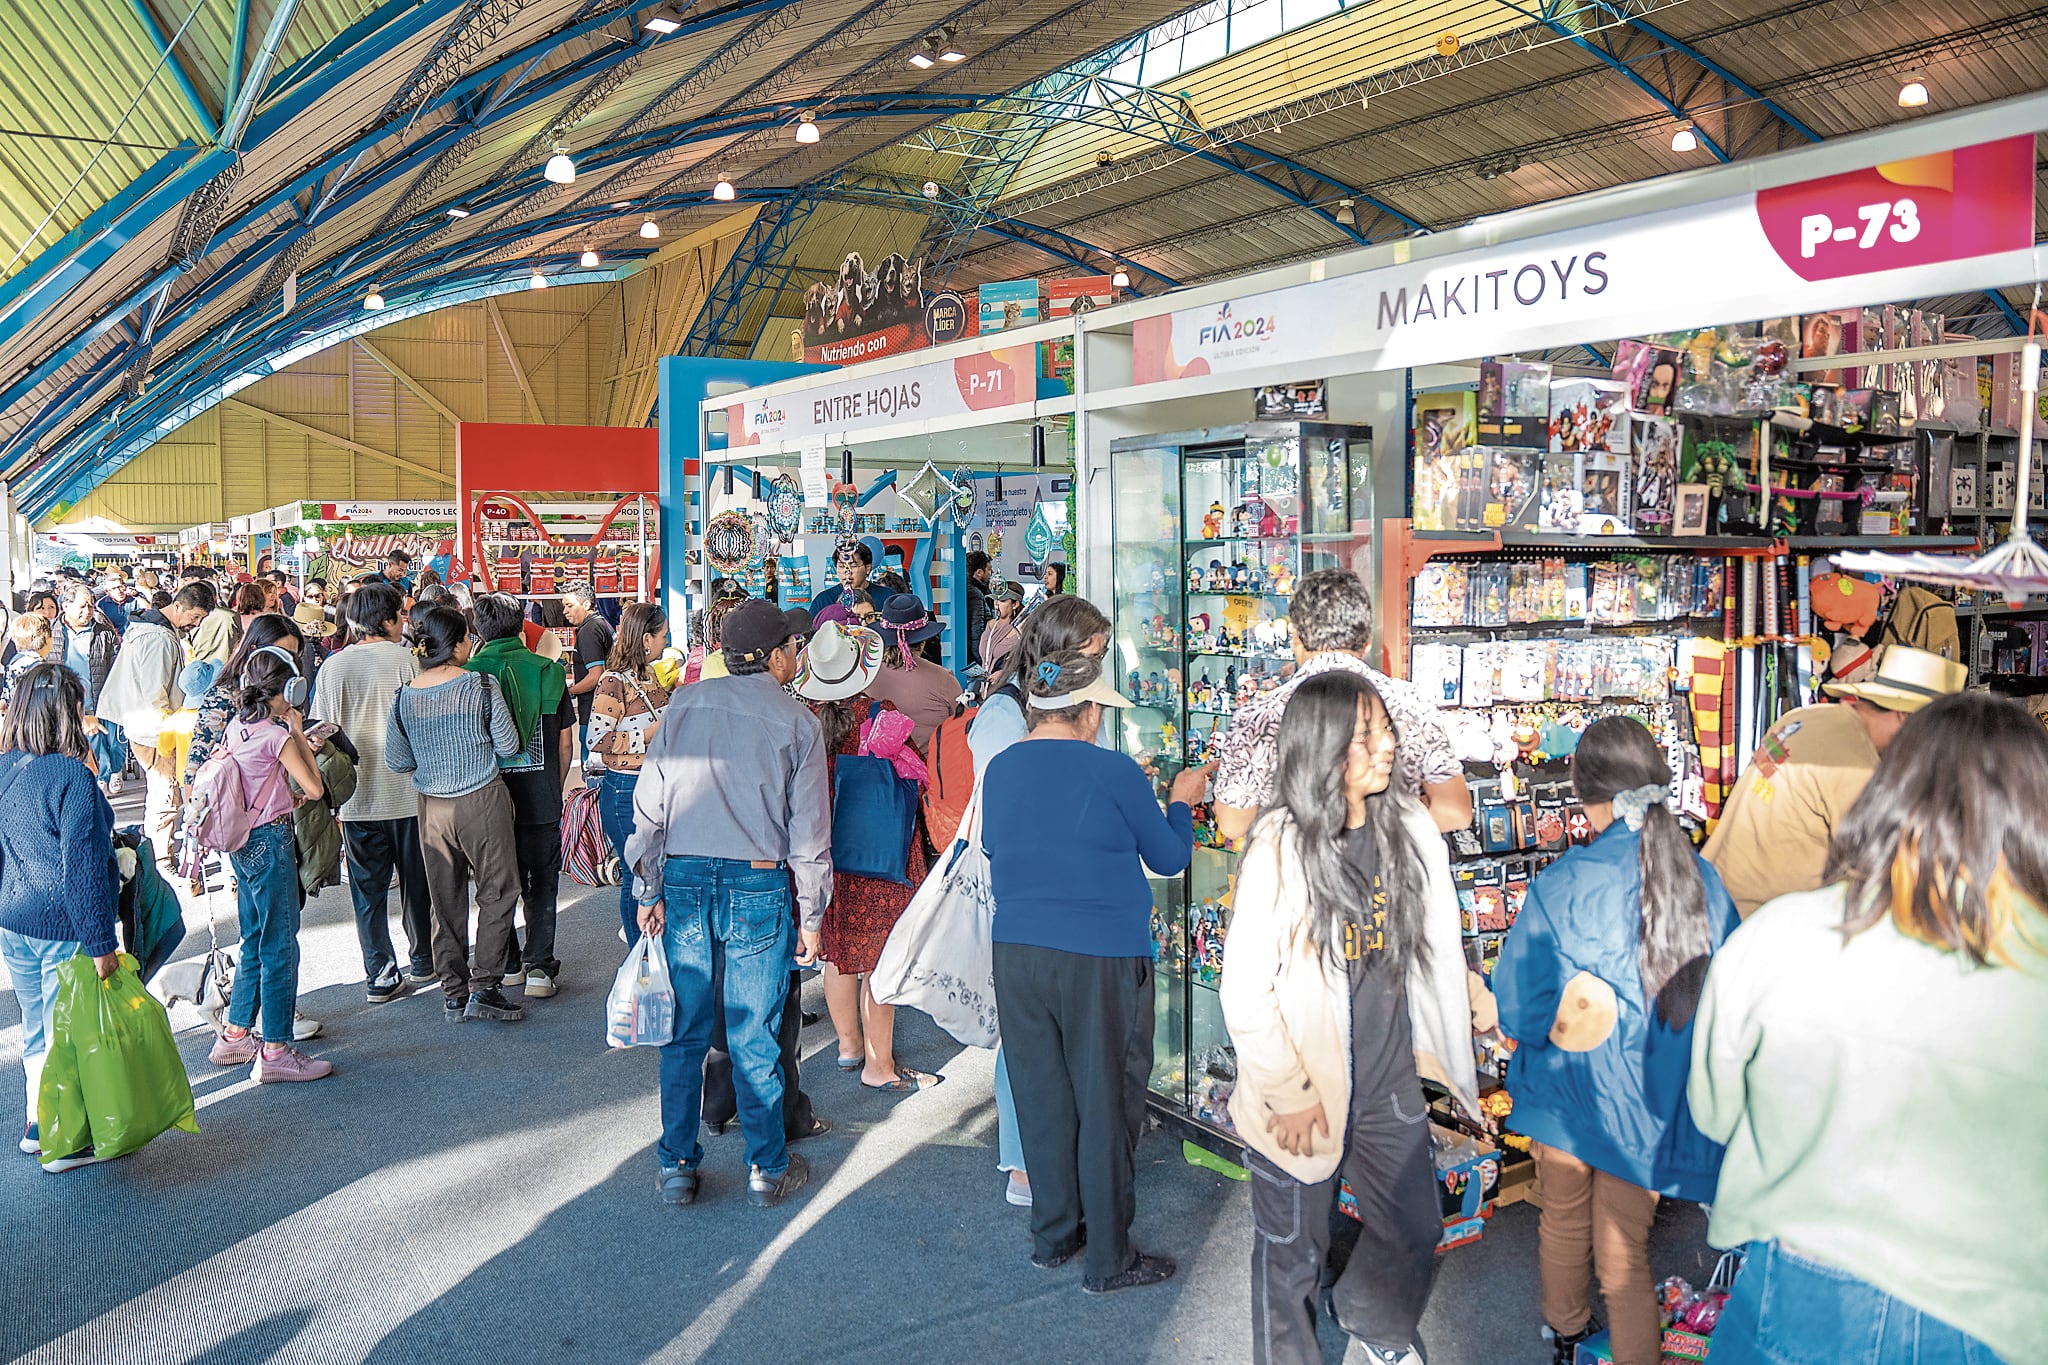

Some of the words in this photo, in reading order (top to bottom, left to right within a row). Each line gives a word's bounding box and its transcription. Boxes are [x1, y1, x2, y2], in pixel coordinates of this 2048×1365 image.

[1801, 198, 1921, 259] P-73
[1377, 251, 1610, 330] MAKITOYS
[933, 304, 957, 319] MARCA
[821, 344, 865, 362] Nutriendo
[867, 337, 887, 354] con
[970, 371, 1002, 395] P-71
[814, 393, 862, 425] ENTRE
[867, 382, 921, 418] HOJAS
